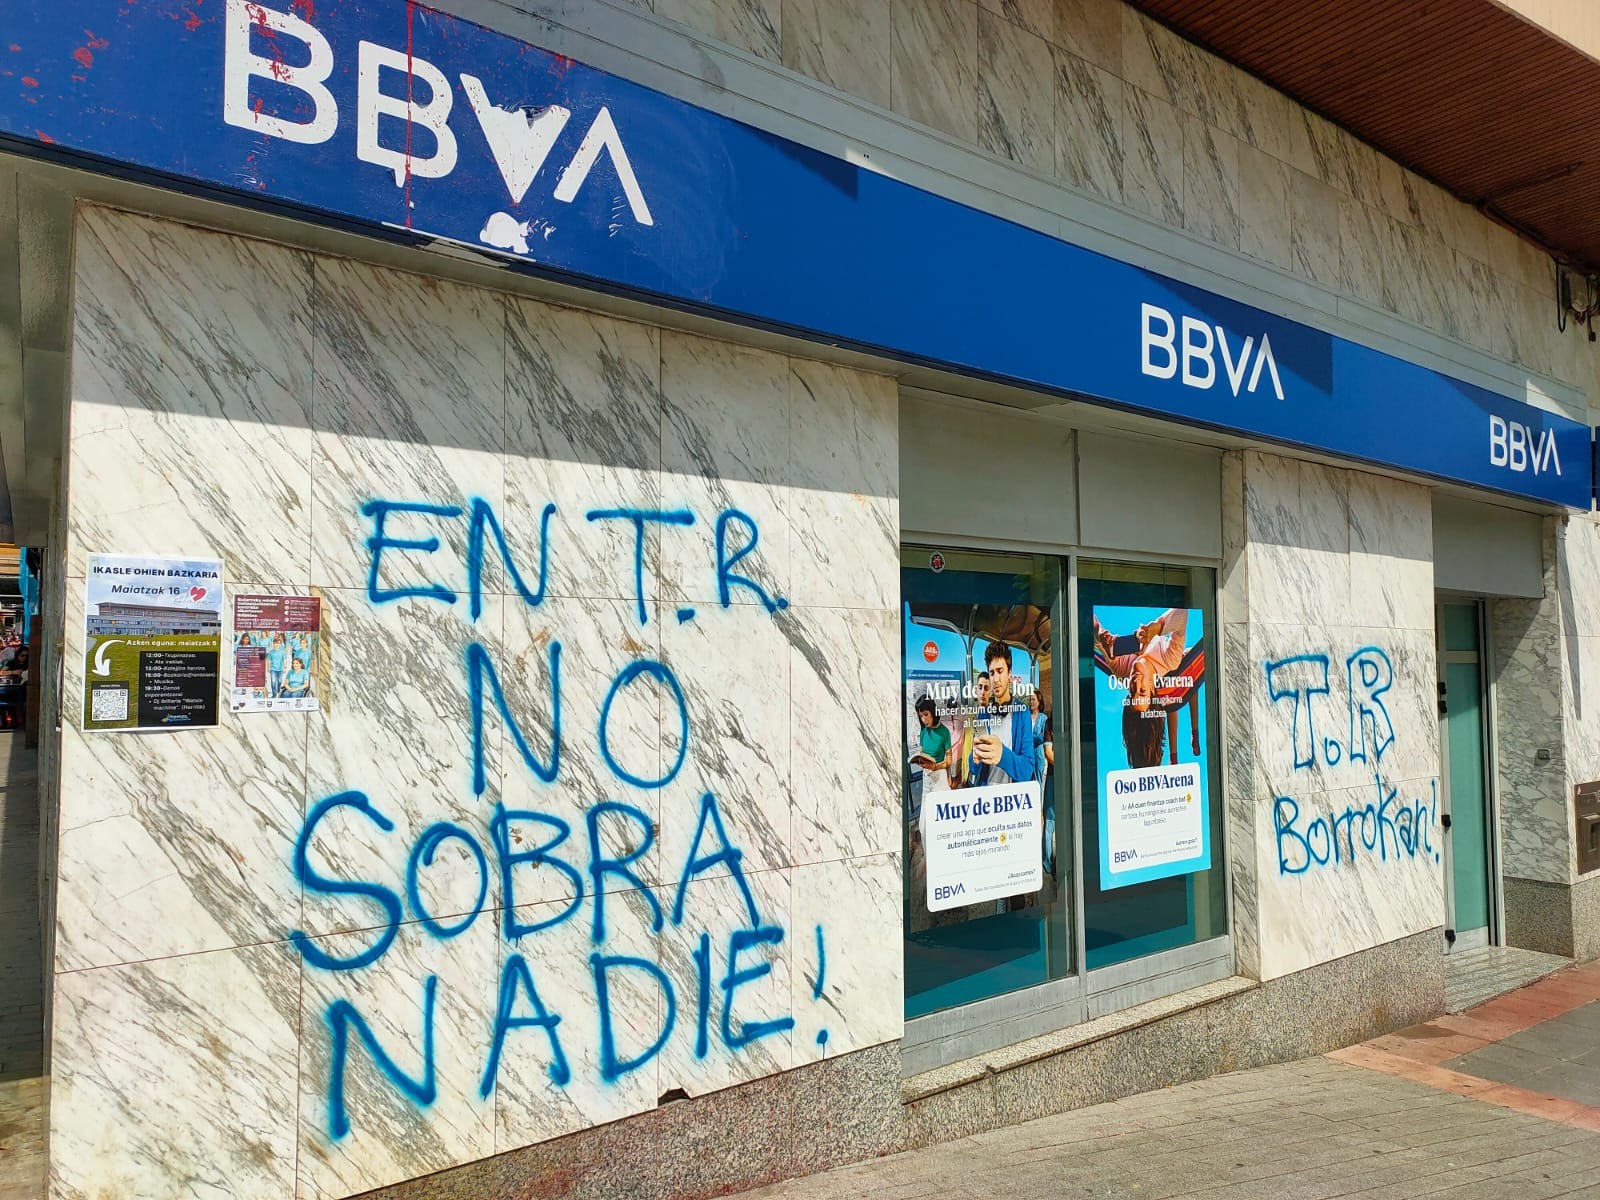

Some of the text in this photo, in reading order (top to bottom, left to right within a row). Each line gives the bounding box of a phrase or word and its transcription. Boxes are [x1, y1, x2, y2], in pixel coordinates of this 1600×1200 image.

[223, 0, 653, 227] BBVA
[1141, 302, 1285, 400] BBVA
[1489, 414, 1561, 476] BBVA
[361, 498, 556, 623] EN
[93, 566, 218, 579] IKASLE OHIEN BAZKARIA
[111, 584, 180, 595] Maiatzak 16
[152, 640, 176, 648] eguna:
[1108, 674, 1131, 690] Oso
[925, 682, 961, 704] Muy
[467, 640, 689, 798] NO
[935, 701, 1027, 717] hacer bizum de camino
[963, 717, 1001, 729] al cumple
[1114, 774, 1195, 795] Oso BBVArena
[935, 792, 1033, 822] Muy de BBVA
[965, 829, 976, 839] app
[988, 824, 1005, 833] oculta
[1007, 822, 1016, 830] sus
[1017, 820, 1033, 829] datos
[947, 836, 999, 850] automáticamente
[1114, 848, 1138, 863] BBVA
[294, 790, 760, 971] SOBRA
[935, 882, 966, 900] BBVA
[326, 925, 828, 1140] NADIE!
